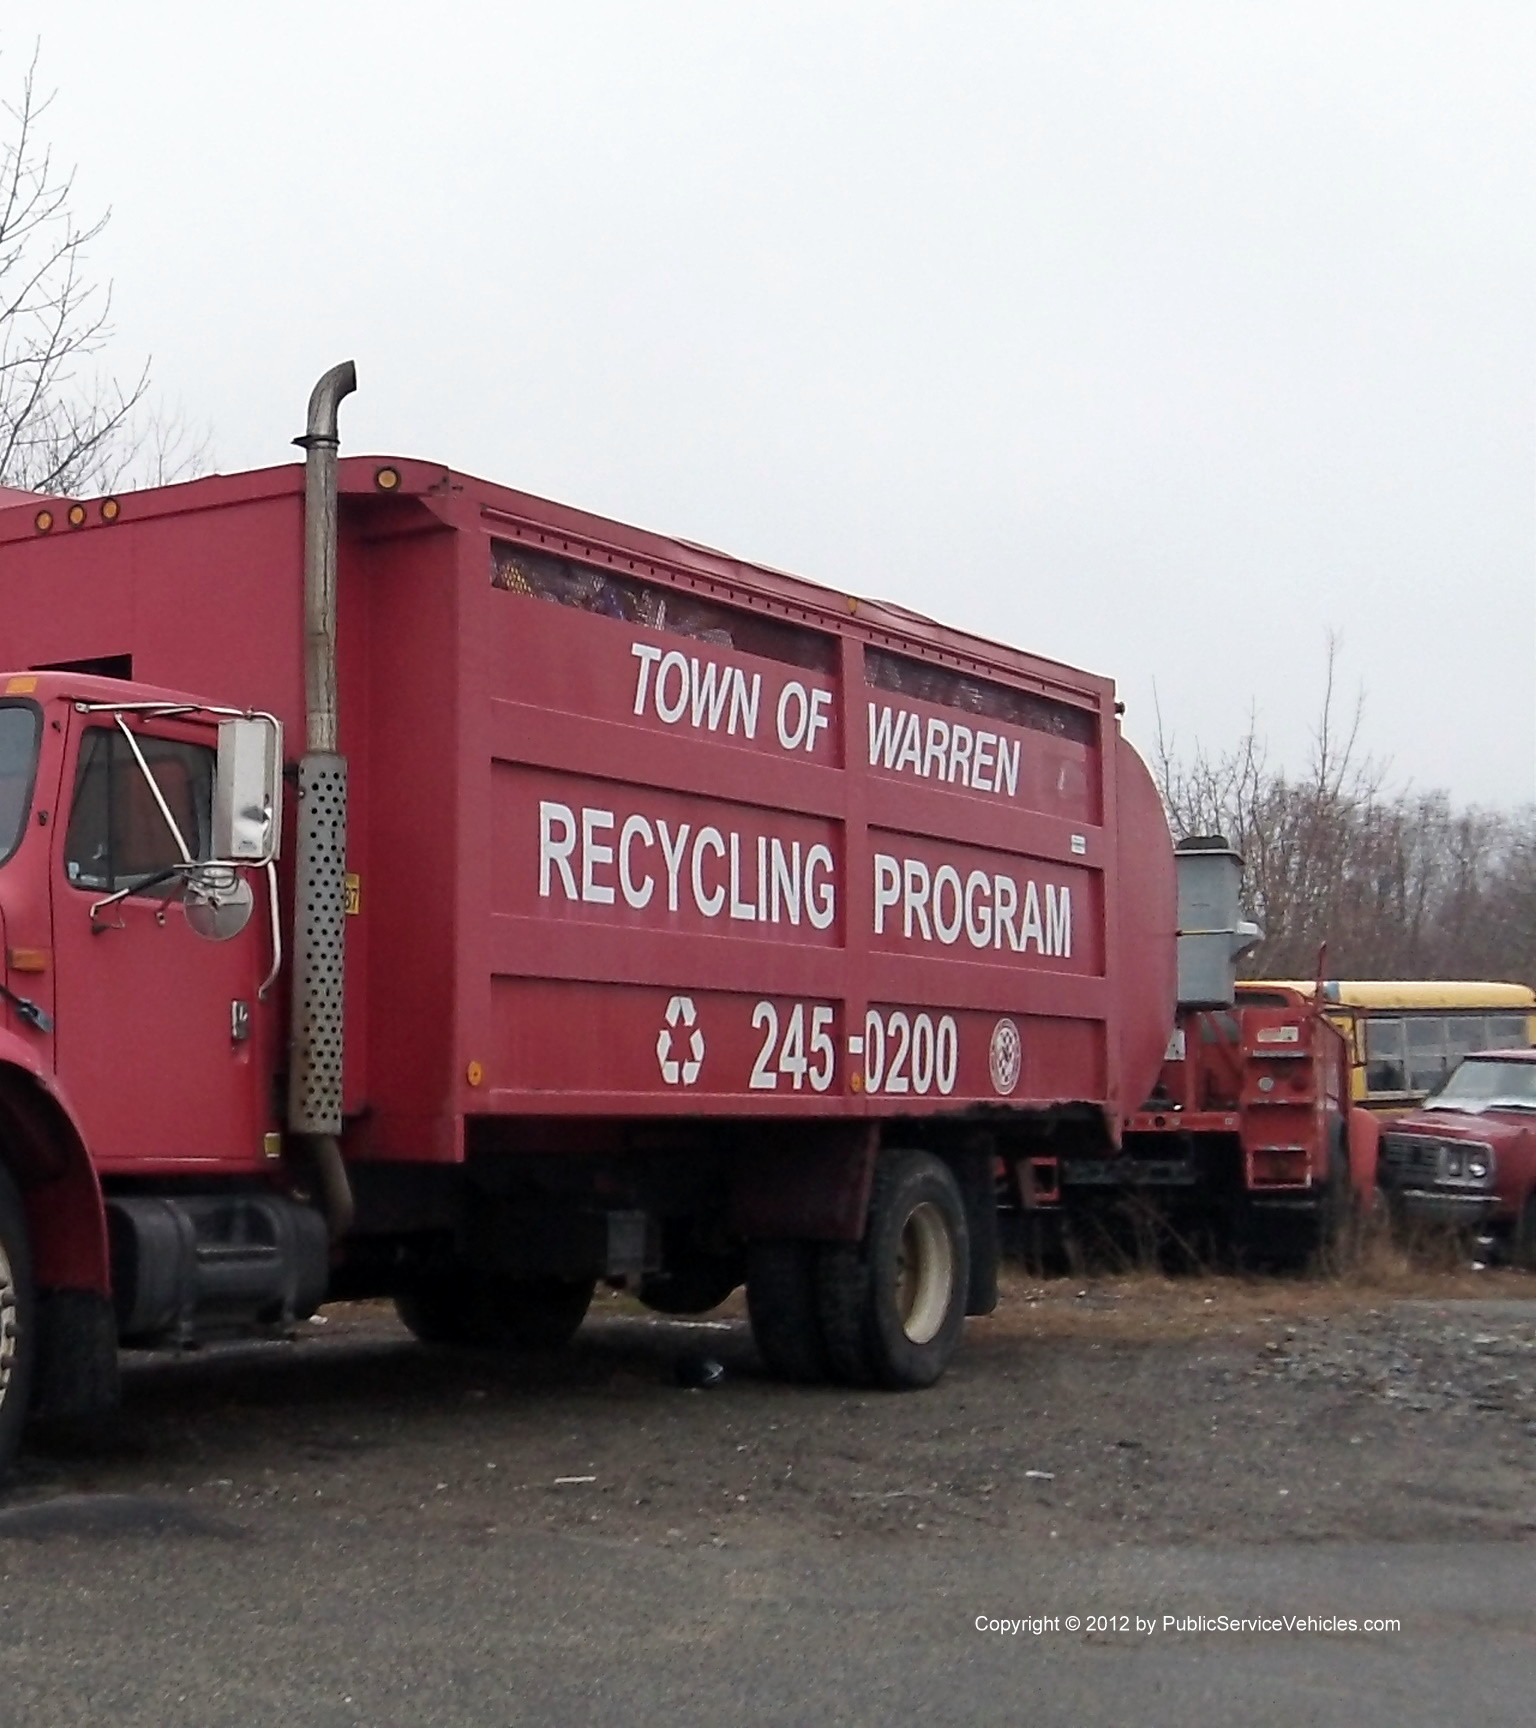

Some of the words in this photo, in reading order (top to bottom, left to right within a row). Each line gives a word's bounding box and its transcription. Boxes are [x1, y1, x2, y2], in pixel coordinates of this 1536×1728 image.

[630, 641, 762, 741] TOWN
[776, 681, 833, 753] OF
[867, 701, 1021, 798] WARREN
[538, 800, 835, 931] RECYCLING
[873, 853, 1072, 959] PROGRAM
[749, 1000, 959, 1096] 245-0200
